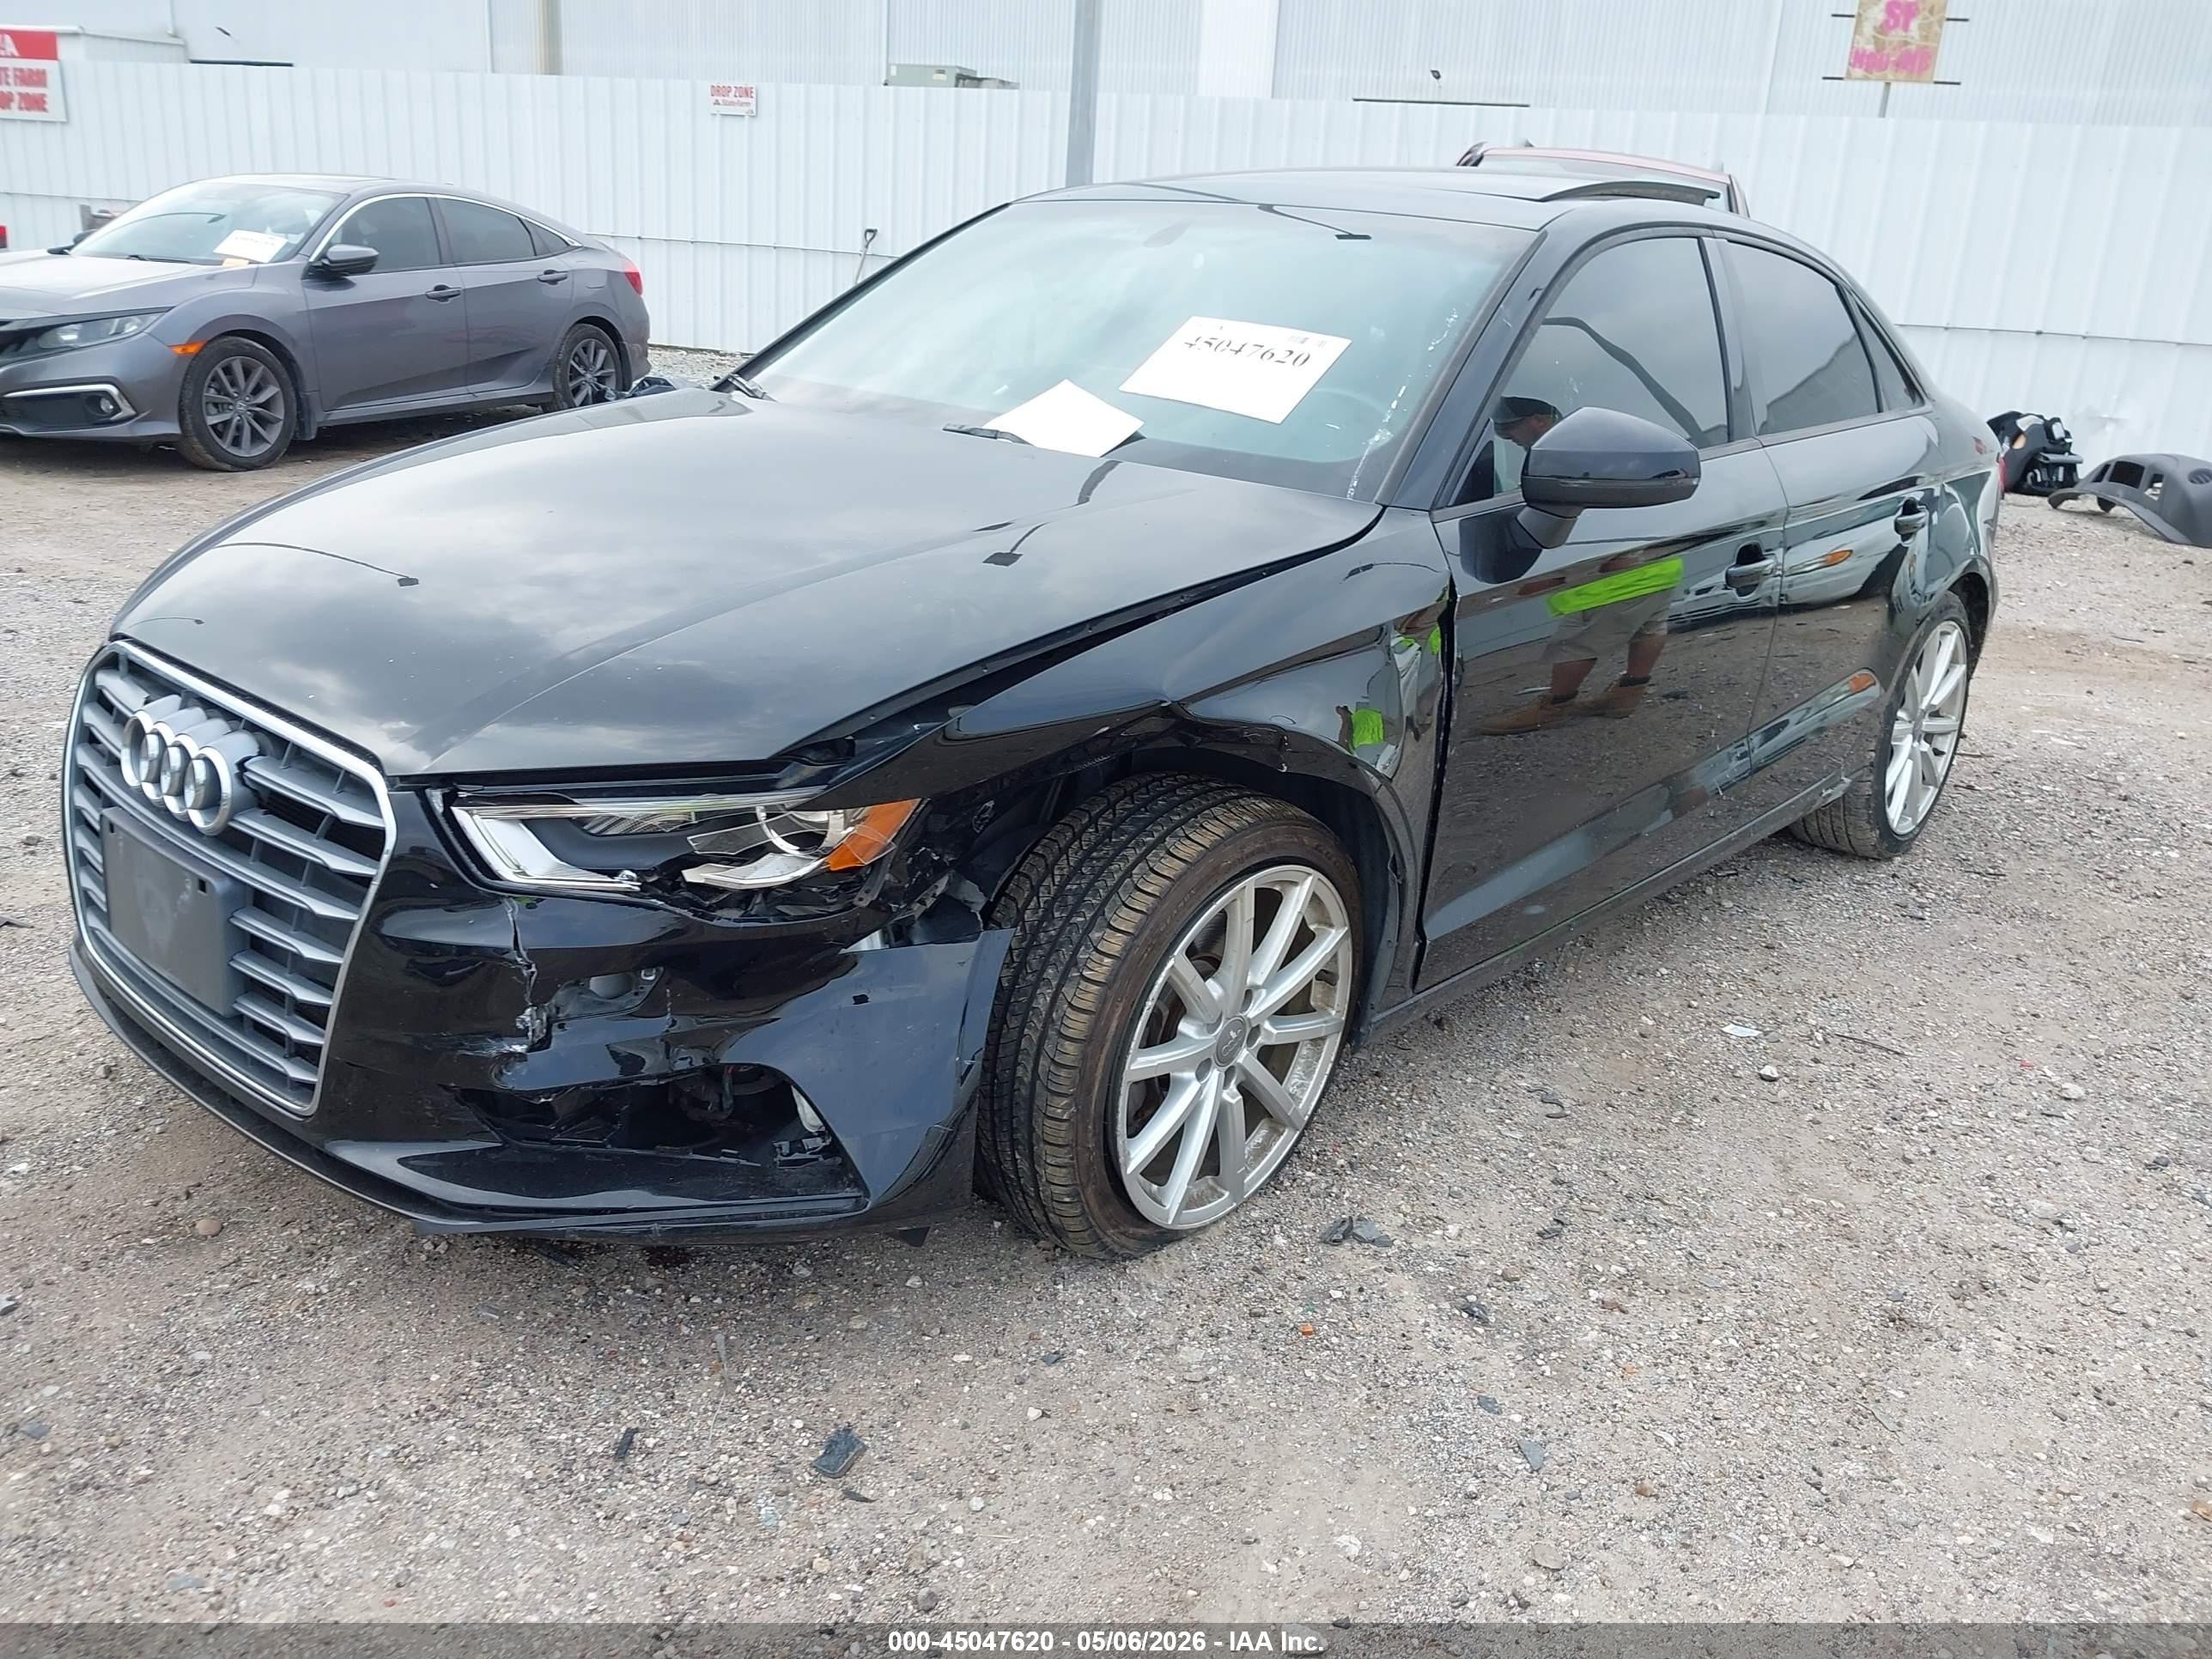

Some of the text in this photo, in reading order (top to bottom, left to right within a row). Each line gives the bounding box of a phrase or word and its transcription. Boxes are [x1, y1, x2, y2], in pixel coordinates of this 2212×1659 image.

[17, 91, 49, 112] ZONE
[734, 86, 754, 98] ZONE
[1184, 335, 1311, 367] 45047620
